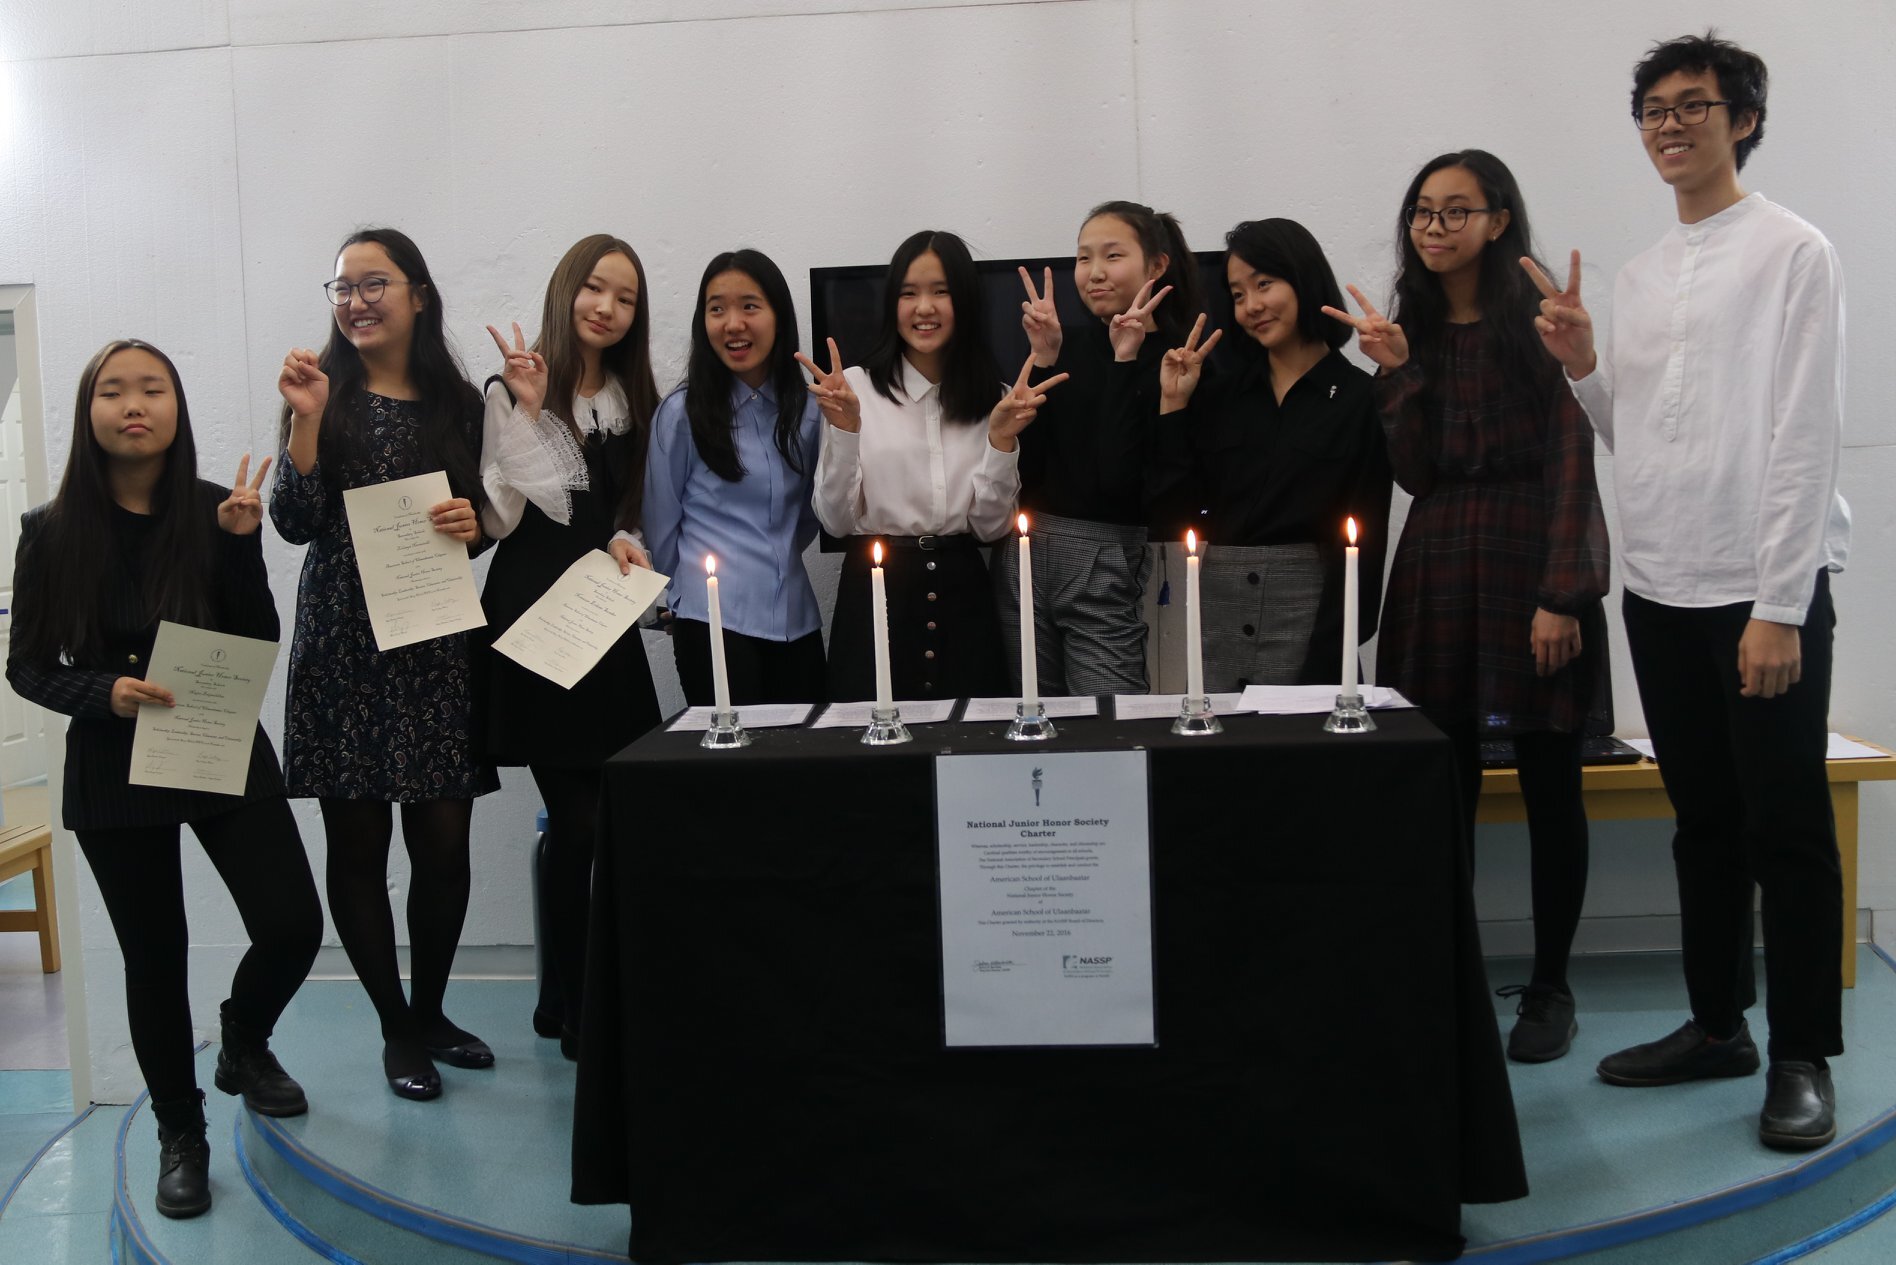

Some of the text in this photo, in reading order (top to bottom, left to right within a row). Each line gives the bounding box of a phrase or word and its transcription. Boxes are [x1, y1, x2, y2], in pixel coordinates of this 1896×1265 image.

[967, 818, 1109, 828] National Junior Honor Society
